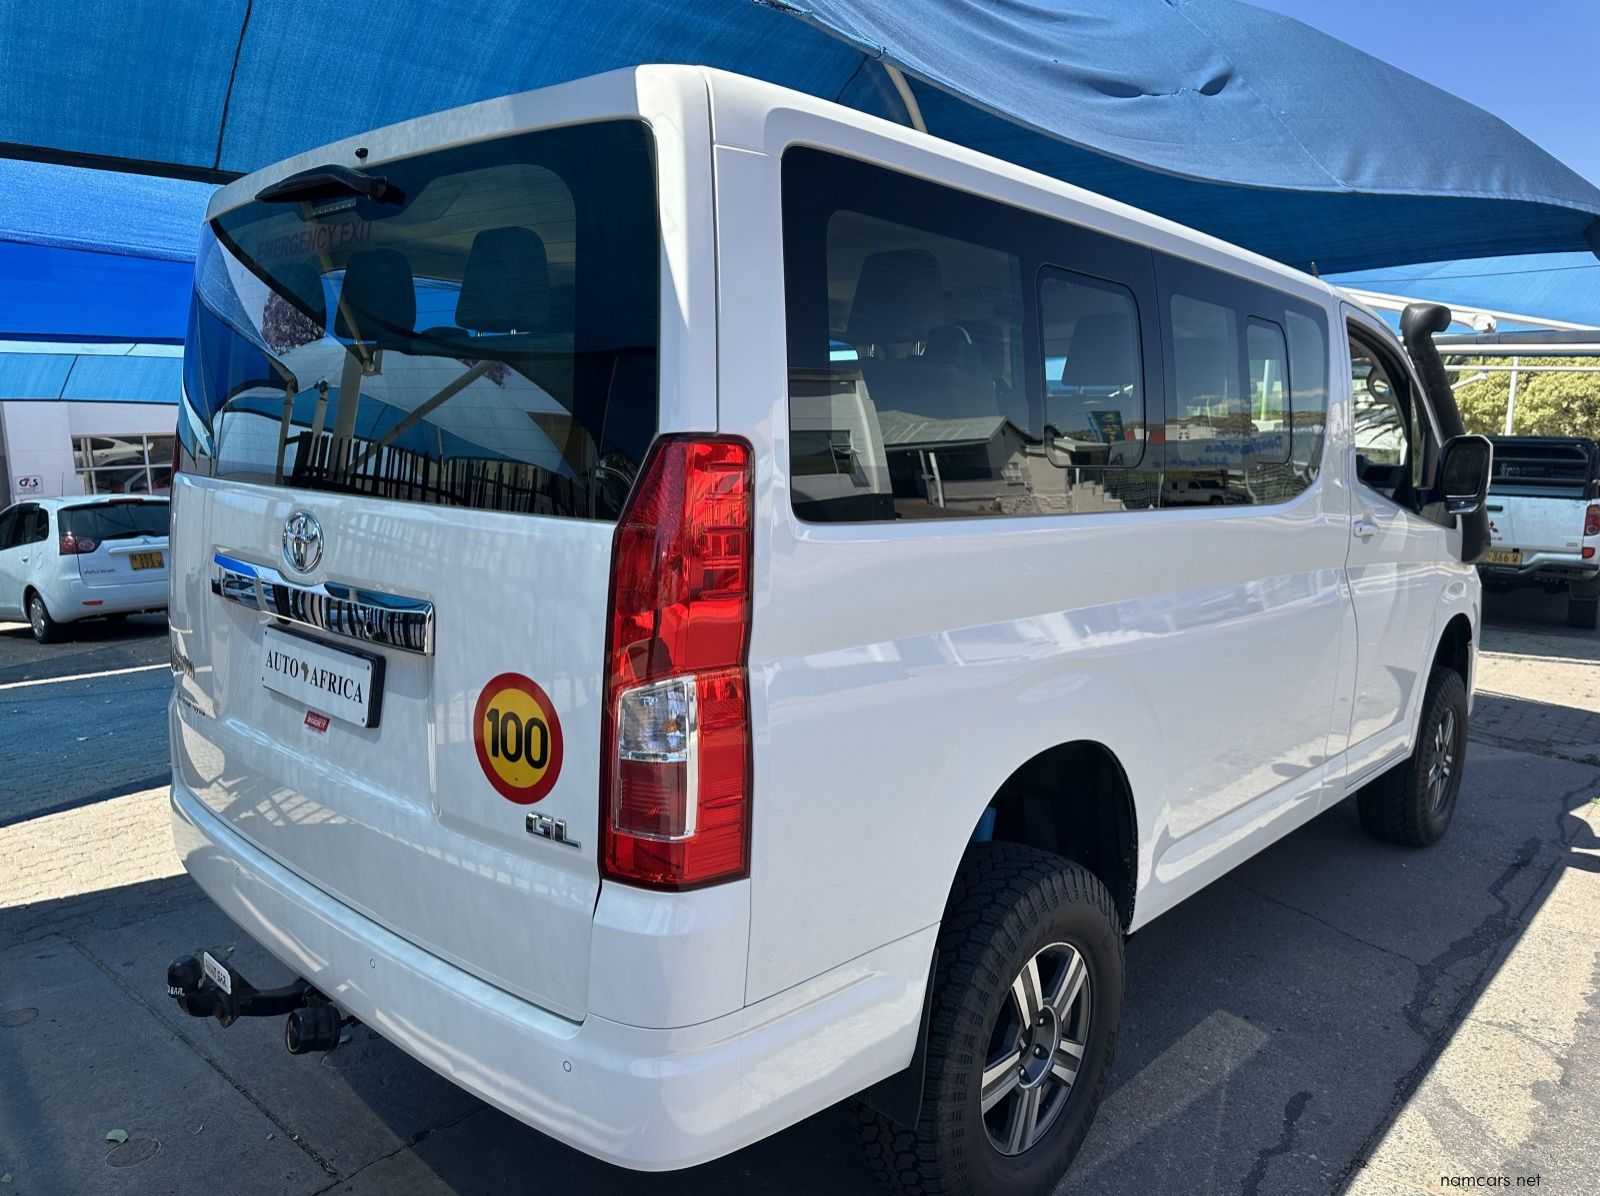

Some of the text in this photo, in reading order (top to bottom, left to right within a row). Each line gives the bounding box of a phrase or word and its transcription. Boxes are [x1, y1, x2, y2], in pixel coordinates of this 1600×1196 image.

[257, 220, 372, 258] EMERGENCY EXIT
[265, 650, 363, 704] AUTO AFRICA
[486, 708, 549, 770] 100
[525, 811, 582, 849] GL
